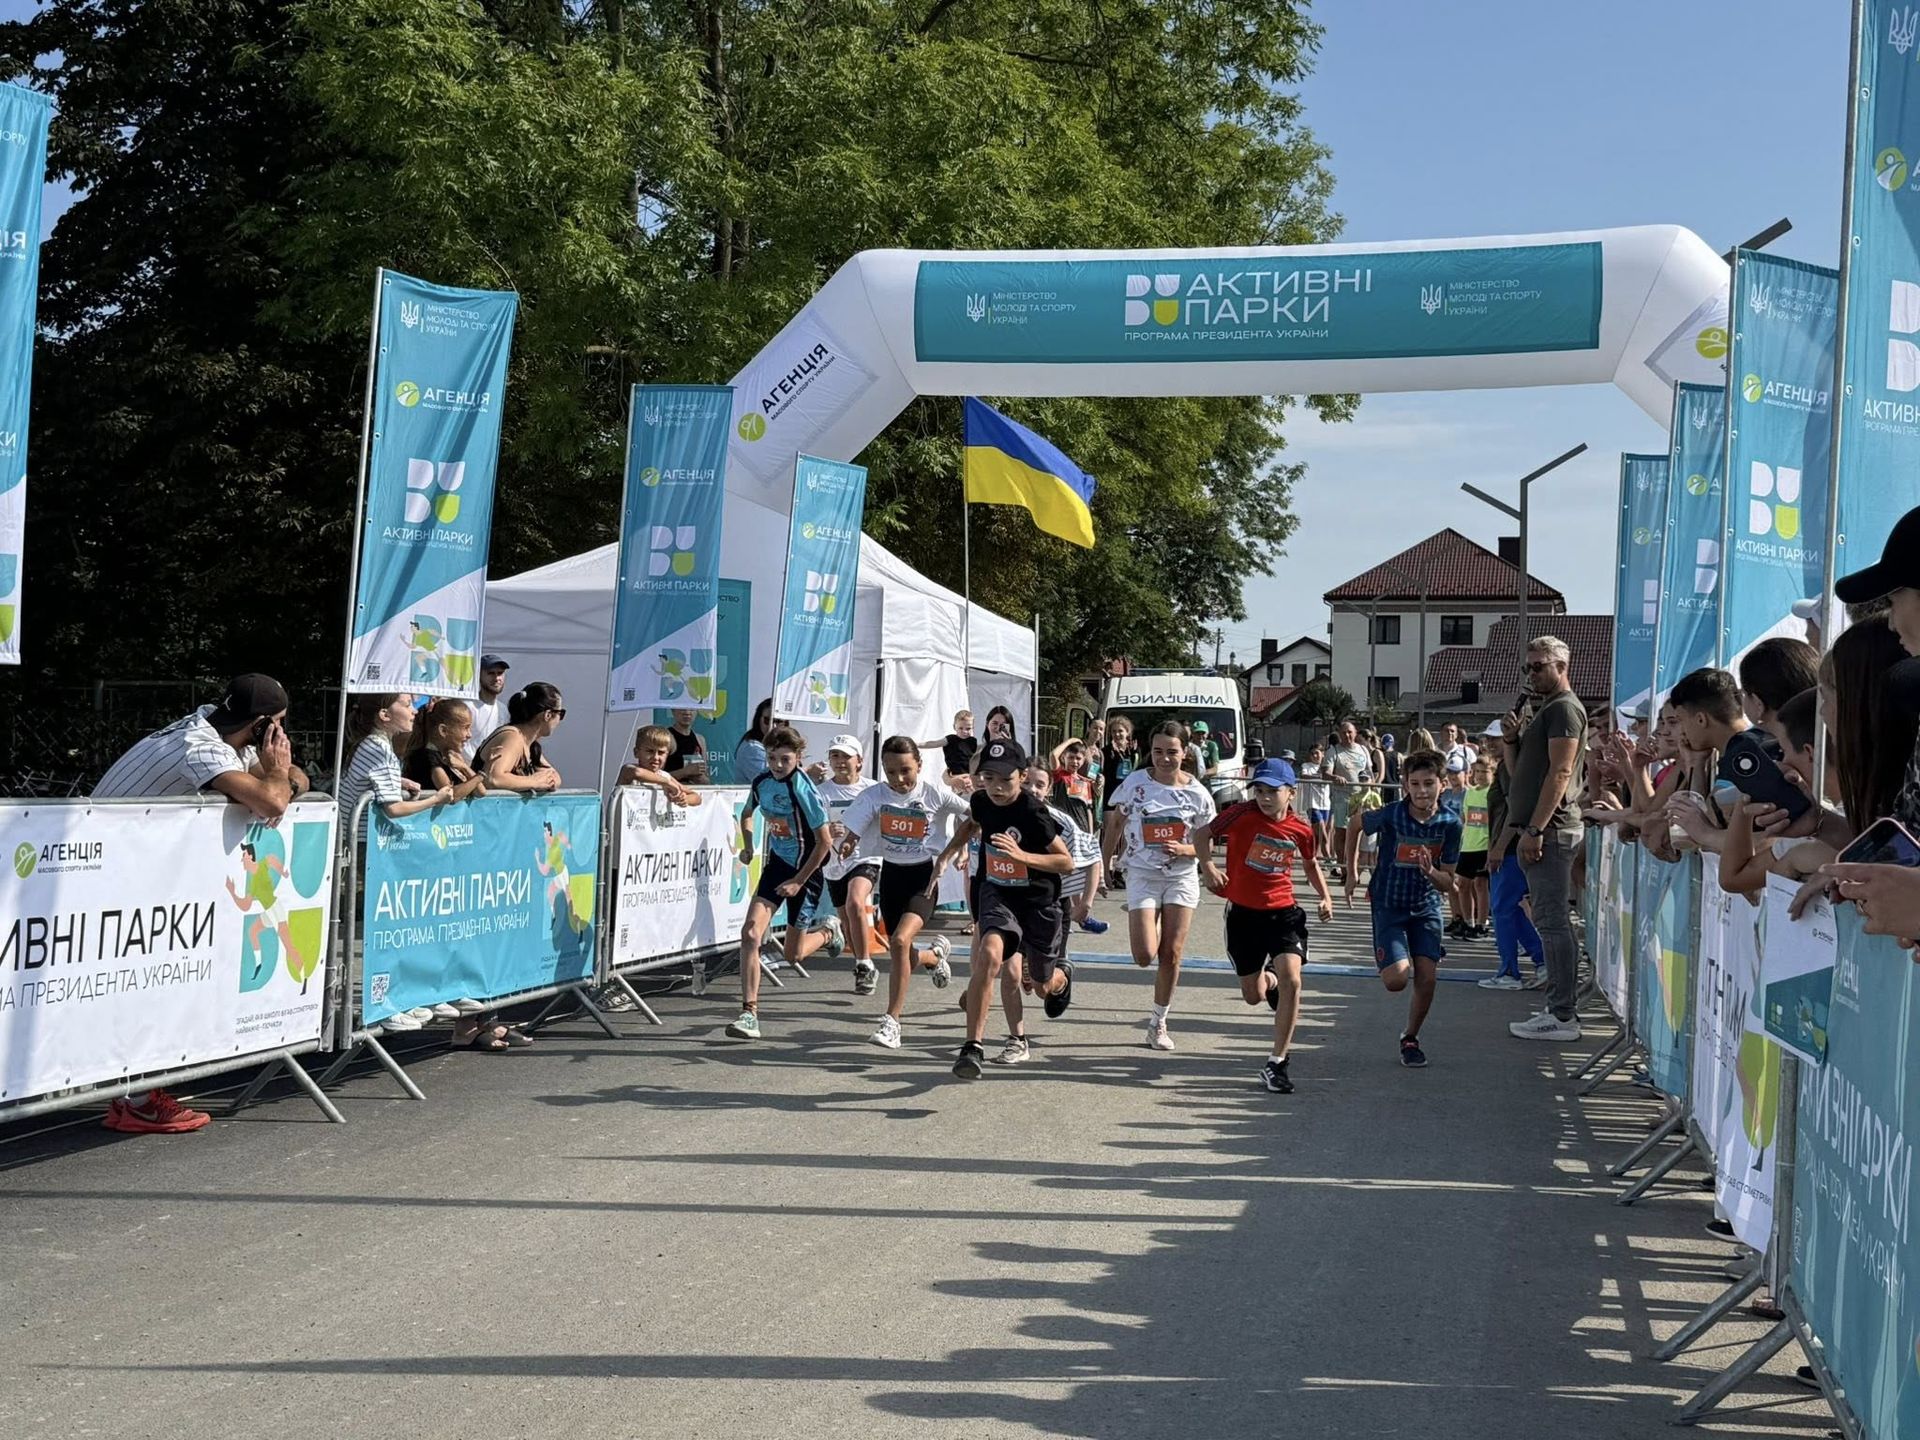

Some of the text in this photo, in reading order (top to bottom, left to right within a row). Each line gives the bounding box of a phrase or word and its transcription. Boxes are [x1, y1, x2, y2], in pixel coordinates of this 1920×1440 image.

[1186, 269, 1372, 297] АКТИВНІ
[992, 292, 1057, 300] МІНІСТЕРСТВО
[1490, 292, 1500, 301] ТА
[1502, 290, 1541, 301] СПОРТУ
[426, 304, 480, 320] МІНІСТЕРСТВО
[992, 304, 1077, 312] МОЛОДІ ТА СПОРТУ
[1185, 296, 1330, 326] ПАРКИ
[1124, 327, 1329, 341] ПРОГРАМА ПРЕЗИДЕНТА УКРАЇНИ
[761, 343, 829, 414] АГЕНЦІЯ
[795, 376, 815, 396] СПОРТУ
[423, 387, 490, 407] АГЕНЦІЯ
[1764, 381, 1828, 406] АГЕНЦІЯ
[662, 468, 715, 481] АГЕНЦІЯ
[382, 526, 475, 545] АКТИВНІ ПАРКИ
[1736, 539, 1776, 558] АКТИВНІ
[1778, 546, 1818, 563] ПАРКИ
[633, 581, 709, 591] АКТИВНІ ПАРКИ
[890, 819, 913, 832] 501
[1154, 826, 1174, 839] 503
[40, 842, 102, 862] АГЕНЦІЯ
[1260, 849, 1284, 864] 546
[682, 847, 723, 880] ПАРКИ
[993, 861, 1015, 874] 548
[374, 868, 531, 922] АКТИВНІ ПАРКИ
[98, 901, 216, 961] ПАРКИ
[373, 908, 531, 950] ПРОГРАМА ПРЕЗИДЕНТА УКРАЇНИ
[20, 966, 138, 1007] ПРЕЗИДЕНТА
[142, 956, 212, 990] УКРАЇНИ
